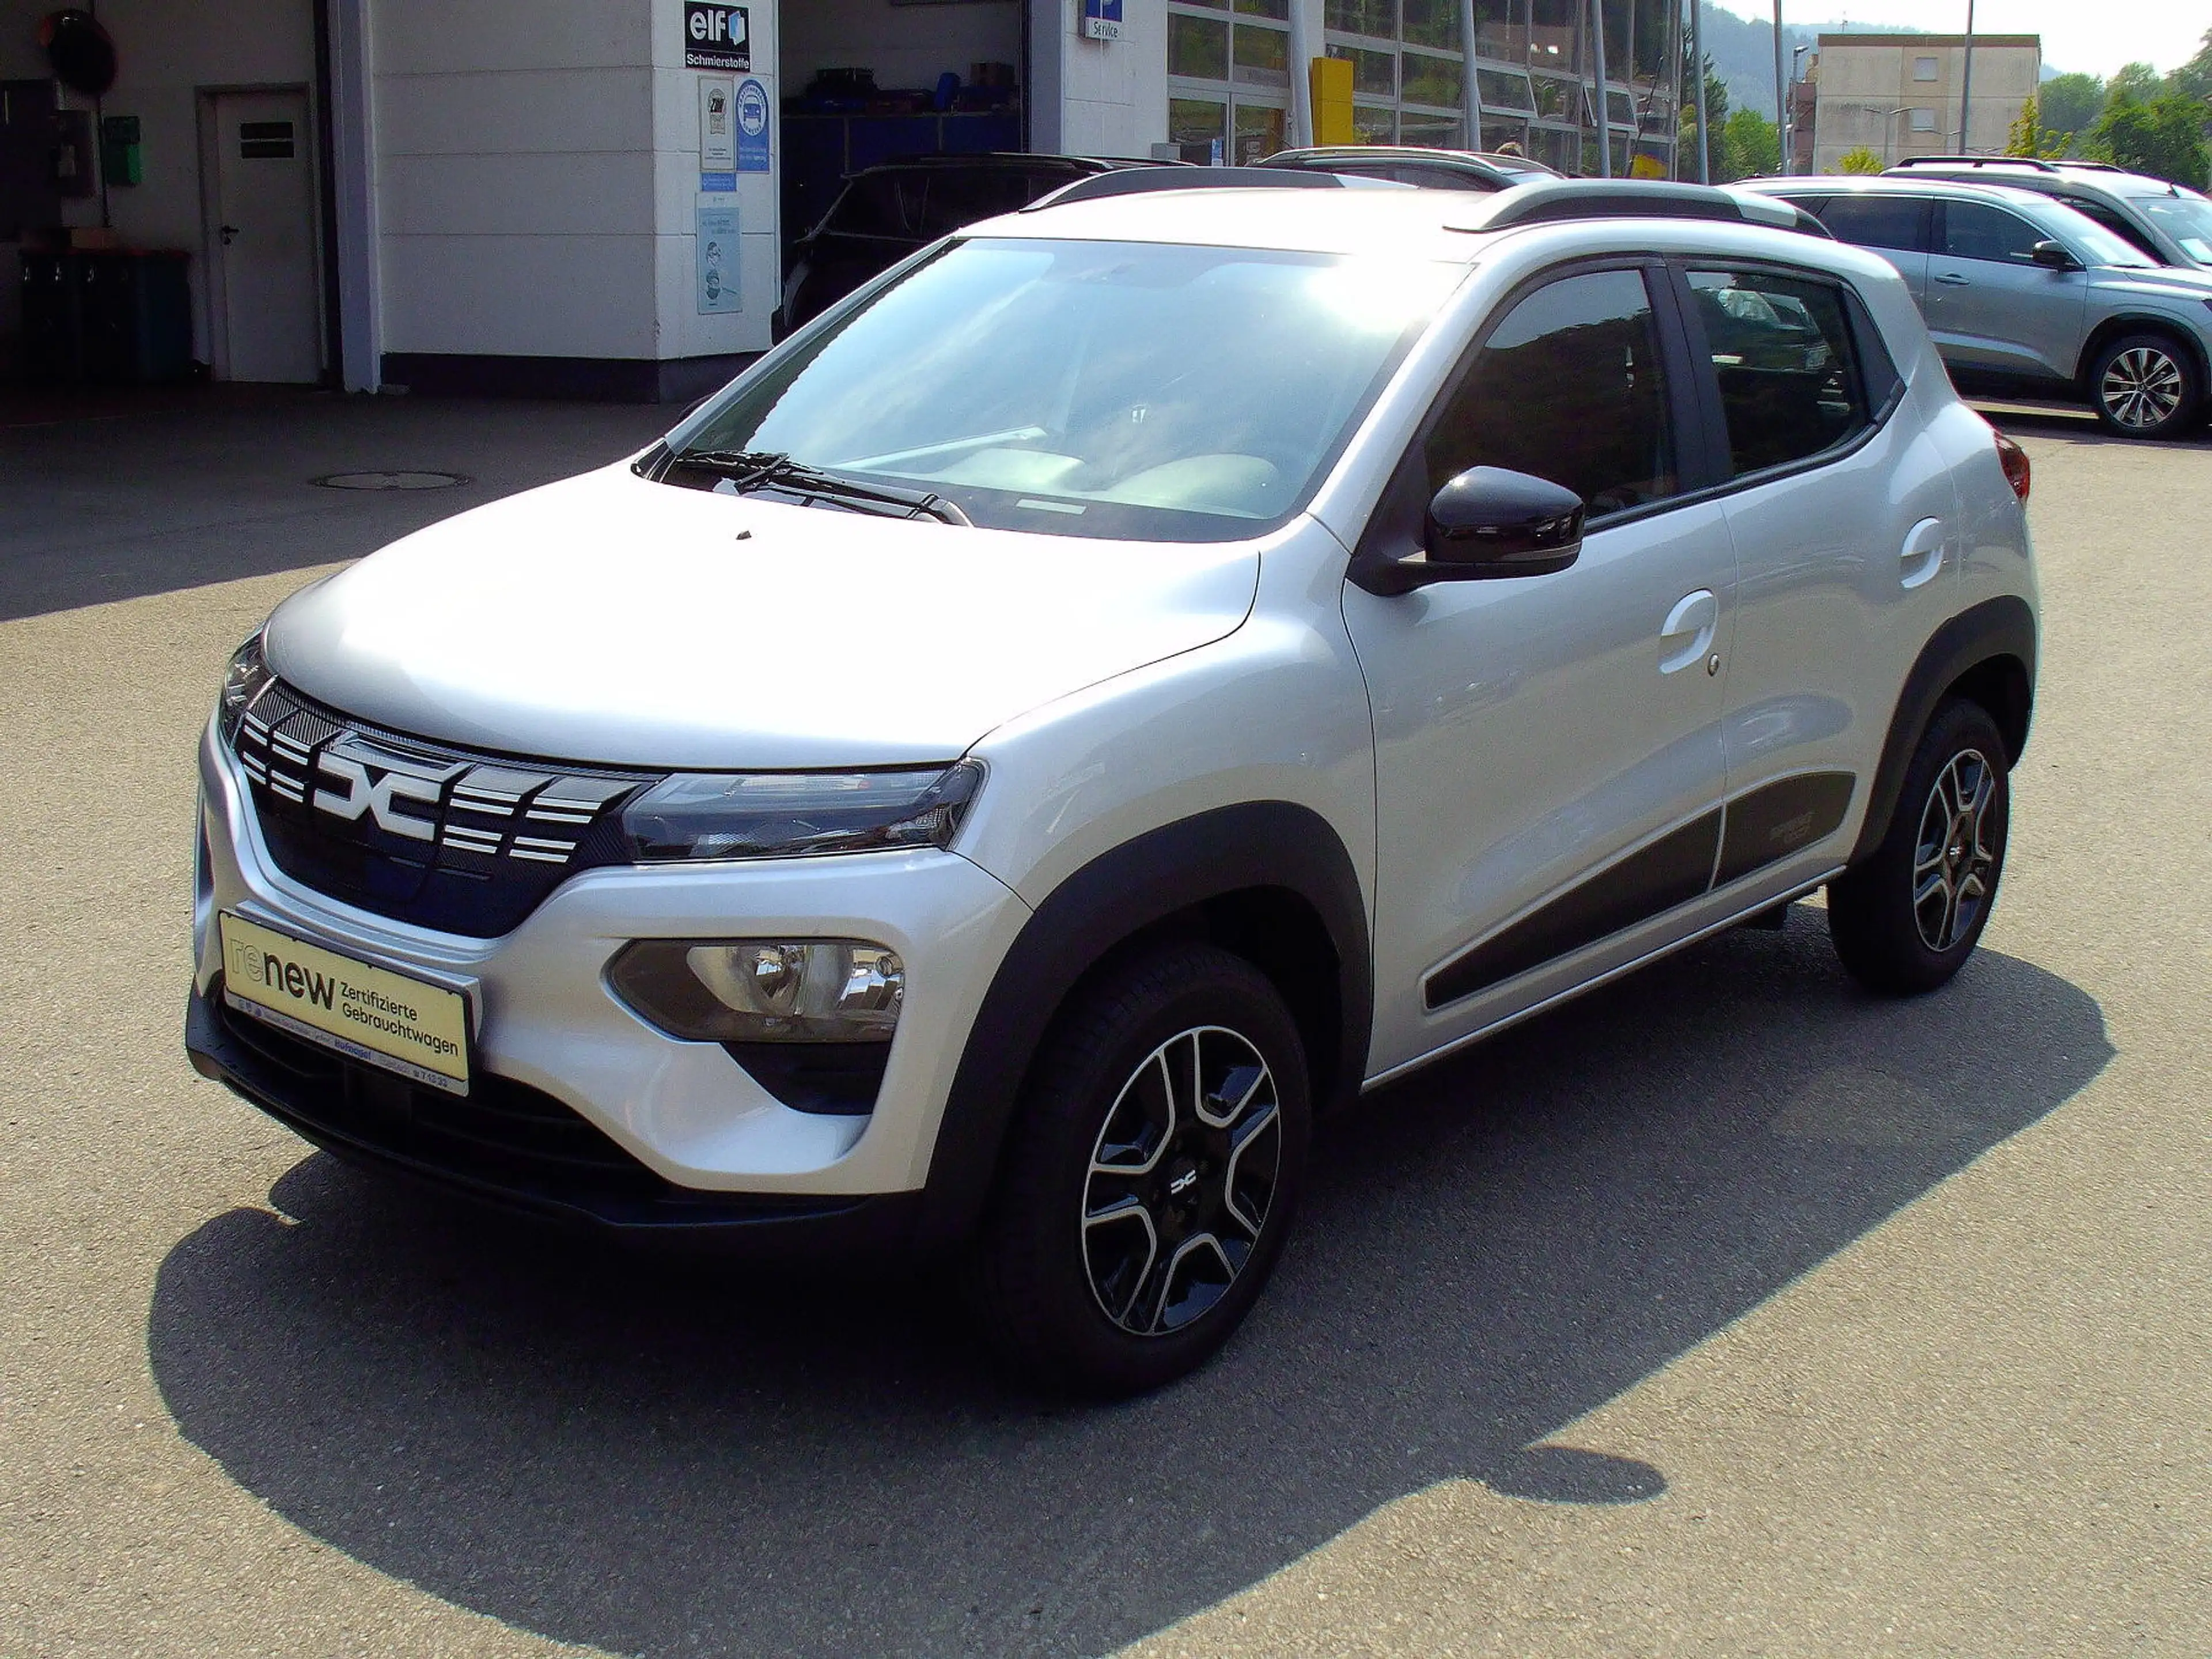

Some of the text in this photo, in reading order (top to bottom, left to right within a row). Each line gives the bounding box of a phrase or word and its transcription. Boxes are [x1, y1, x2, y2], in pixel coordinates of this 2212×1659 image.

[690, 9, 726, 41] elf
[1094, 21, 1118, 37] Service
[687, 54, 749, 69] Schmierstoffe
[340, 982, 418, 1021] Zertifizierte
[342, 1002, 459, 1056] Gebrauchtwagen
